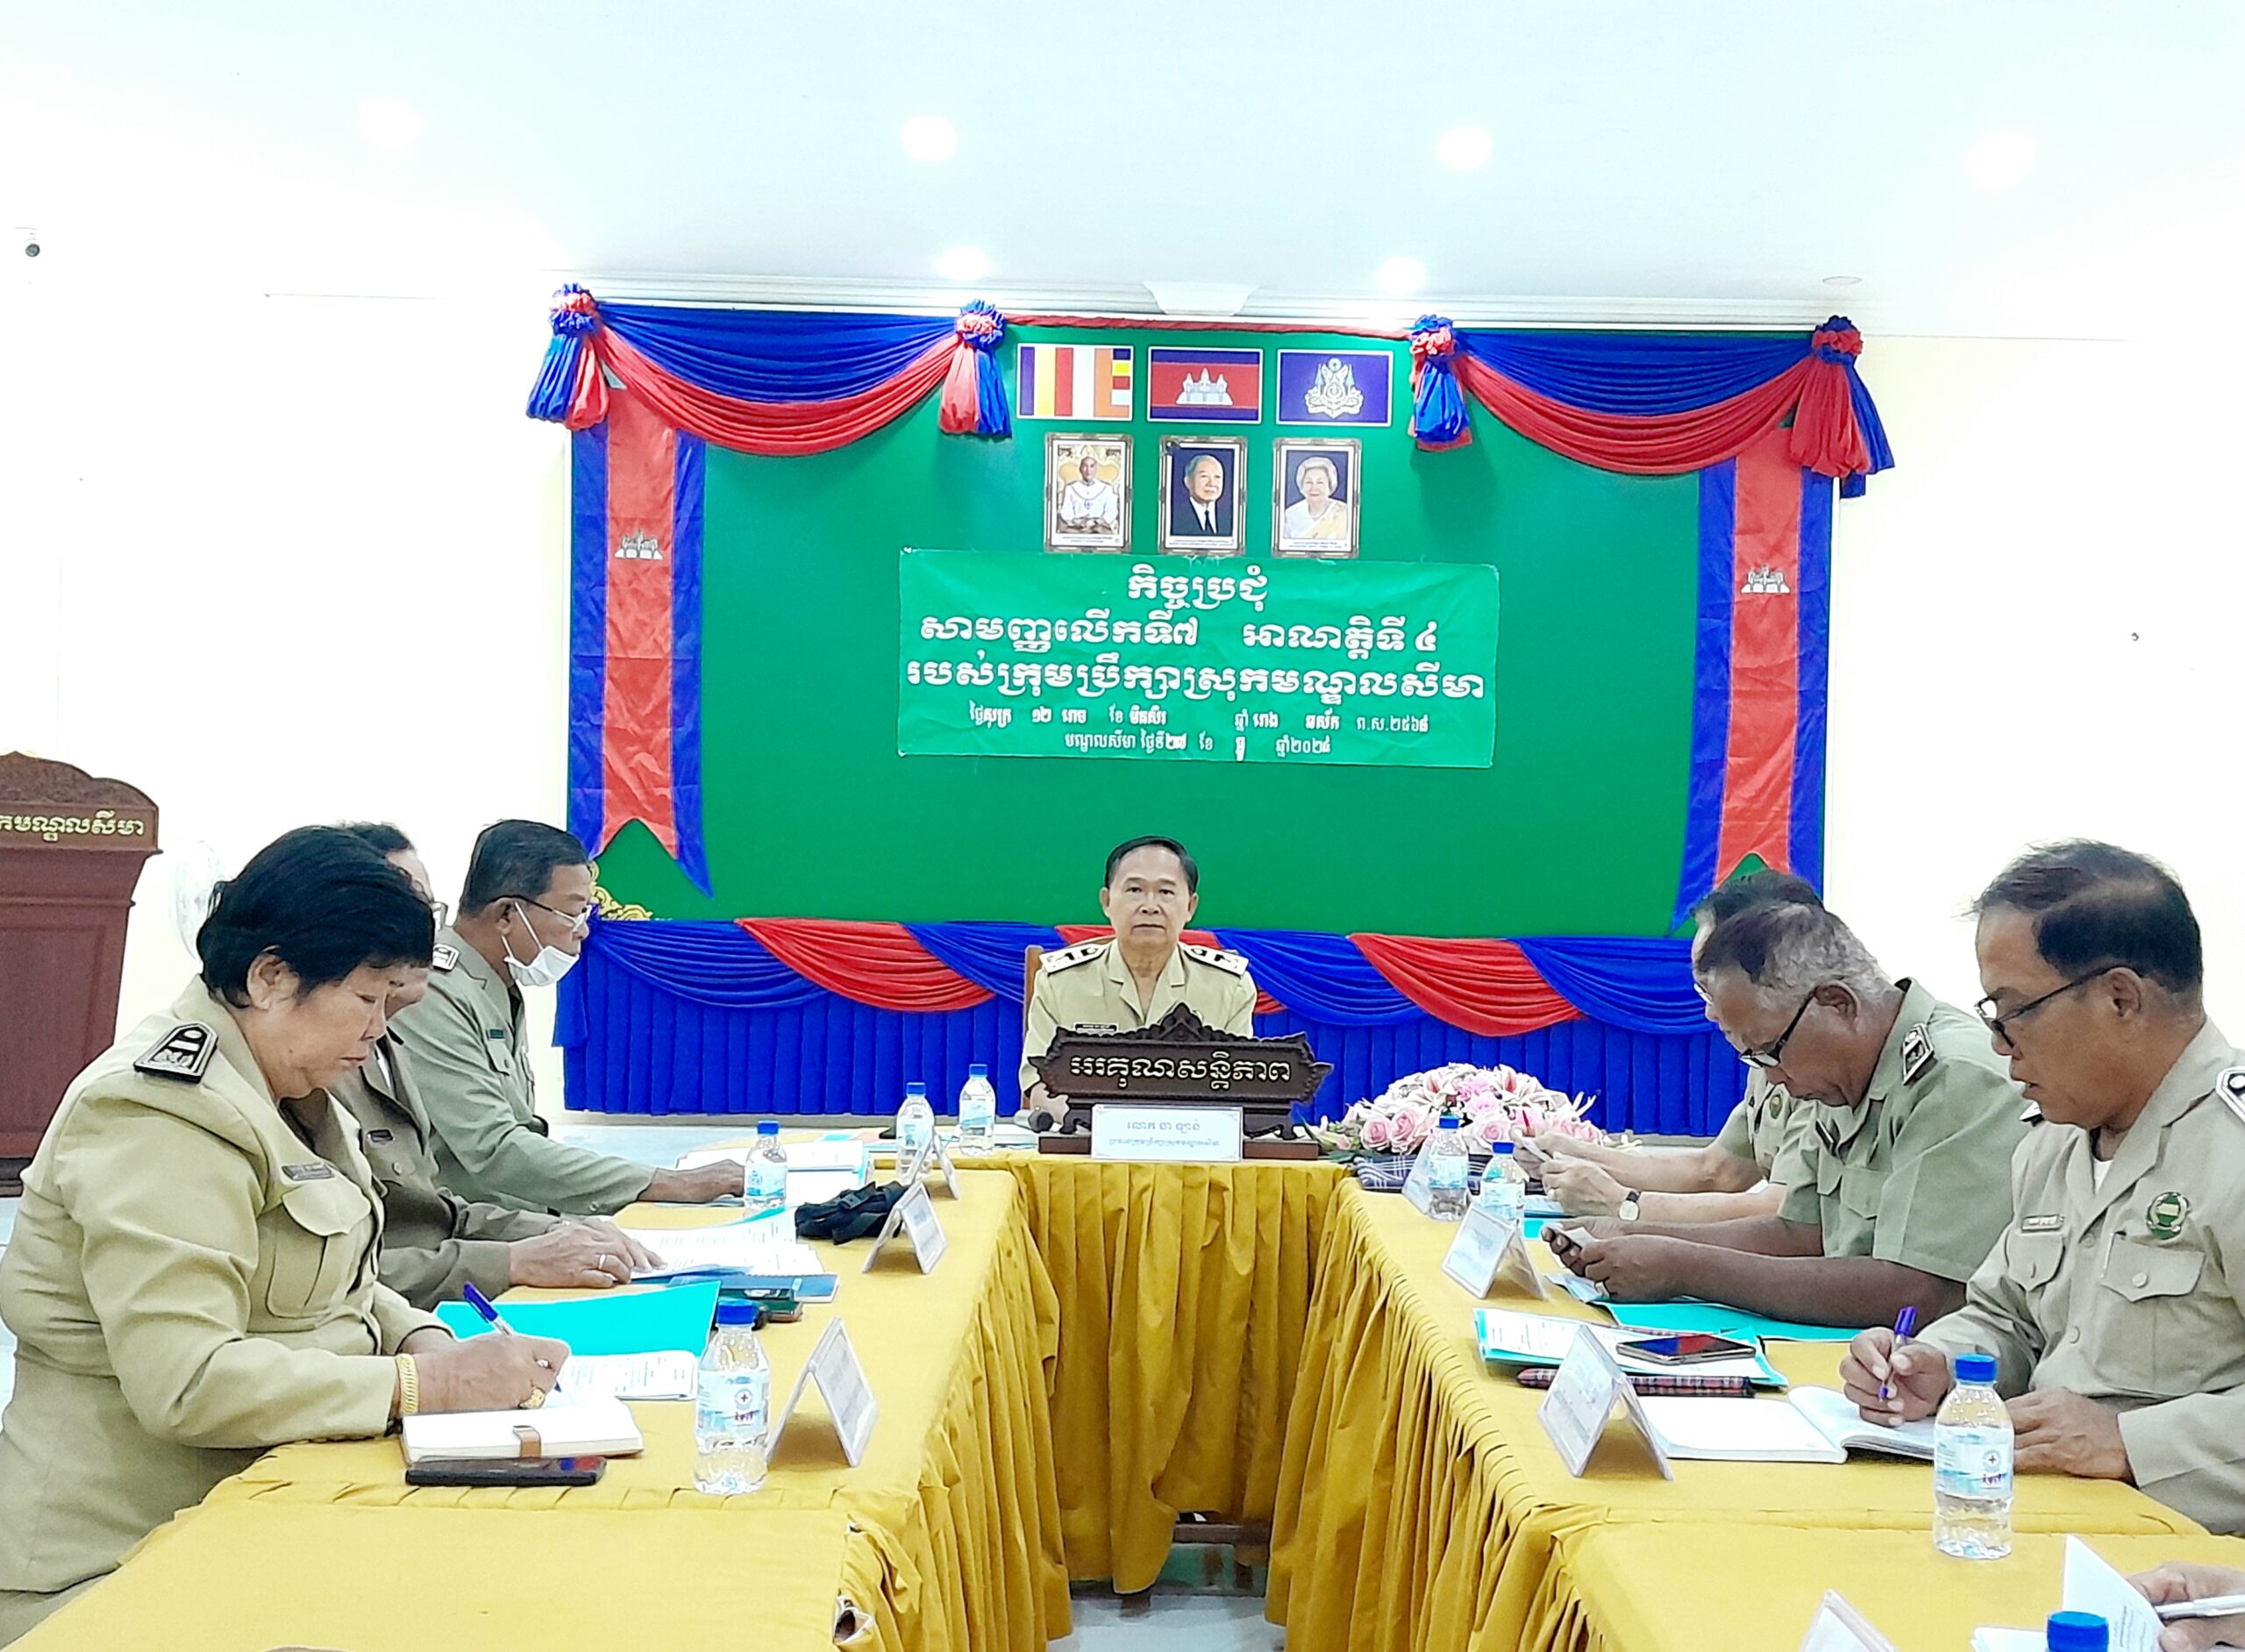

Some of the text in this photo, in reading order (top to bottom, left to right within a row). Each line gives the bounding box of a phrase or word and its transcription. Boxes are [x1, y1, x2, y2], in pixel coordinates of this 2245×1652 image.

[1128, 563, 1268, 612] កិច្ចប្រជុំ
[1415, 621, 1437, 652] ៤
